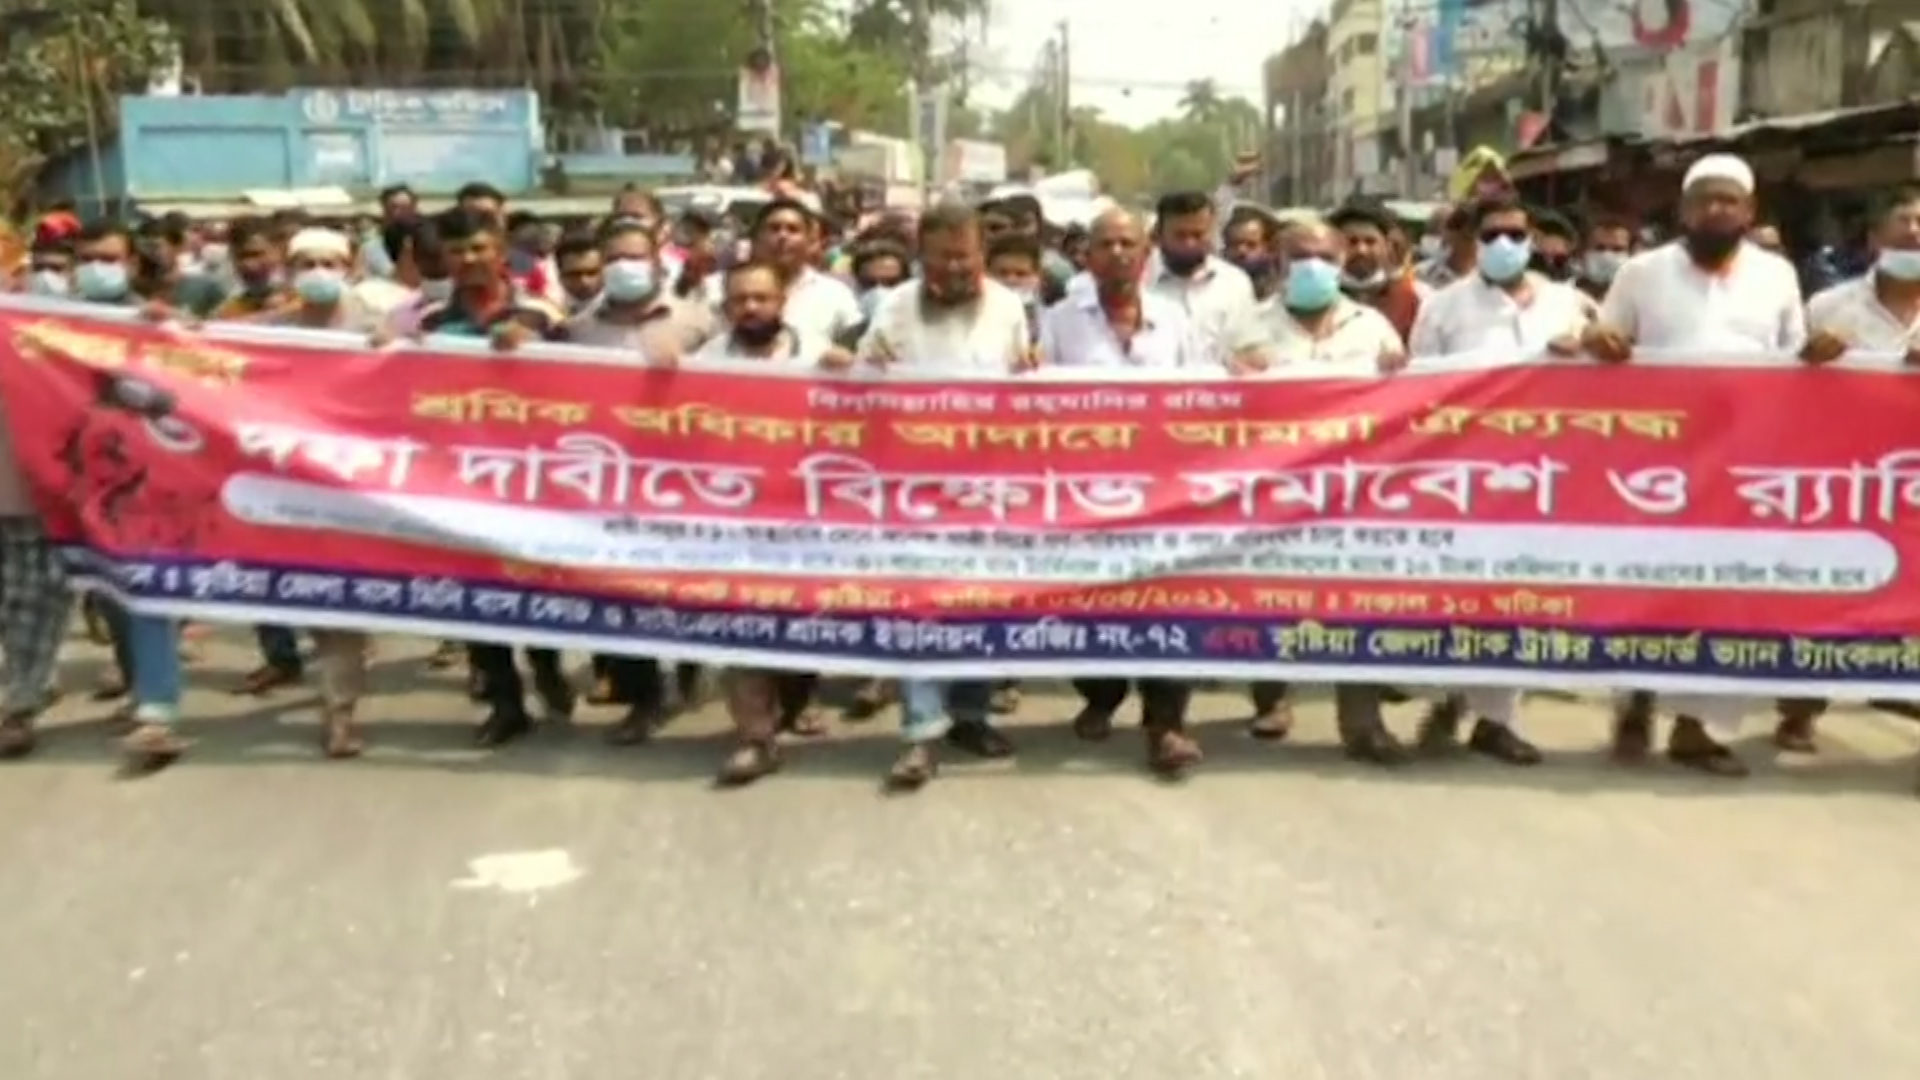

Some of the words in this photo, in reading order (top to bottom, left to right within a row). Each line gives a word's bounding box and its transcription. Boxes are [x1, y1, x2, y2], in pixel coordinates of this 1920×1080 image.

[411, 388, 592, 425] শ্রমিক
[612, 403, 866, 448] অধিকার
[893, 420, 1140, 450] আদায়ে
[1165, 412, 1376, 449] আমরা
[1409, 401, 1688, 440] ঐক্যবদ্ধ
[453, 432, 766, 507] দাবীতে
[790, 453, 1155, 522] বিক্ষোভ
[1178, 455, 1570, 516] সমাবেশ
[1607, 464, 1689, 514] ও
